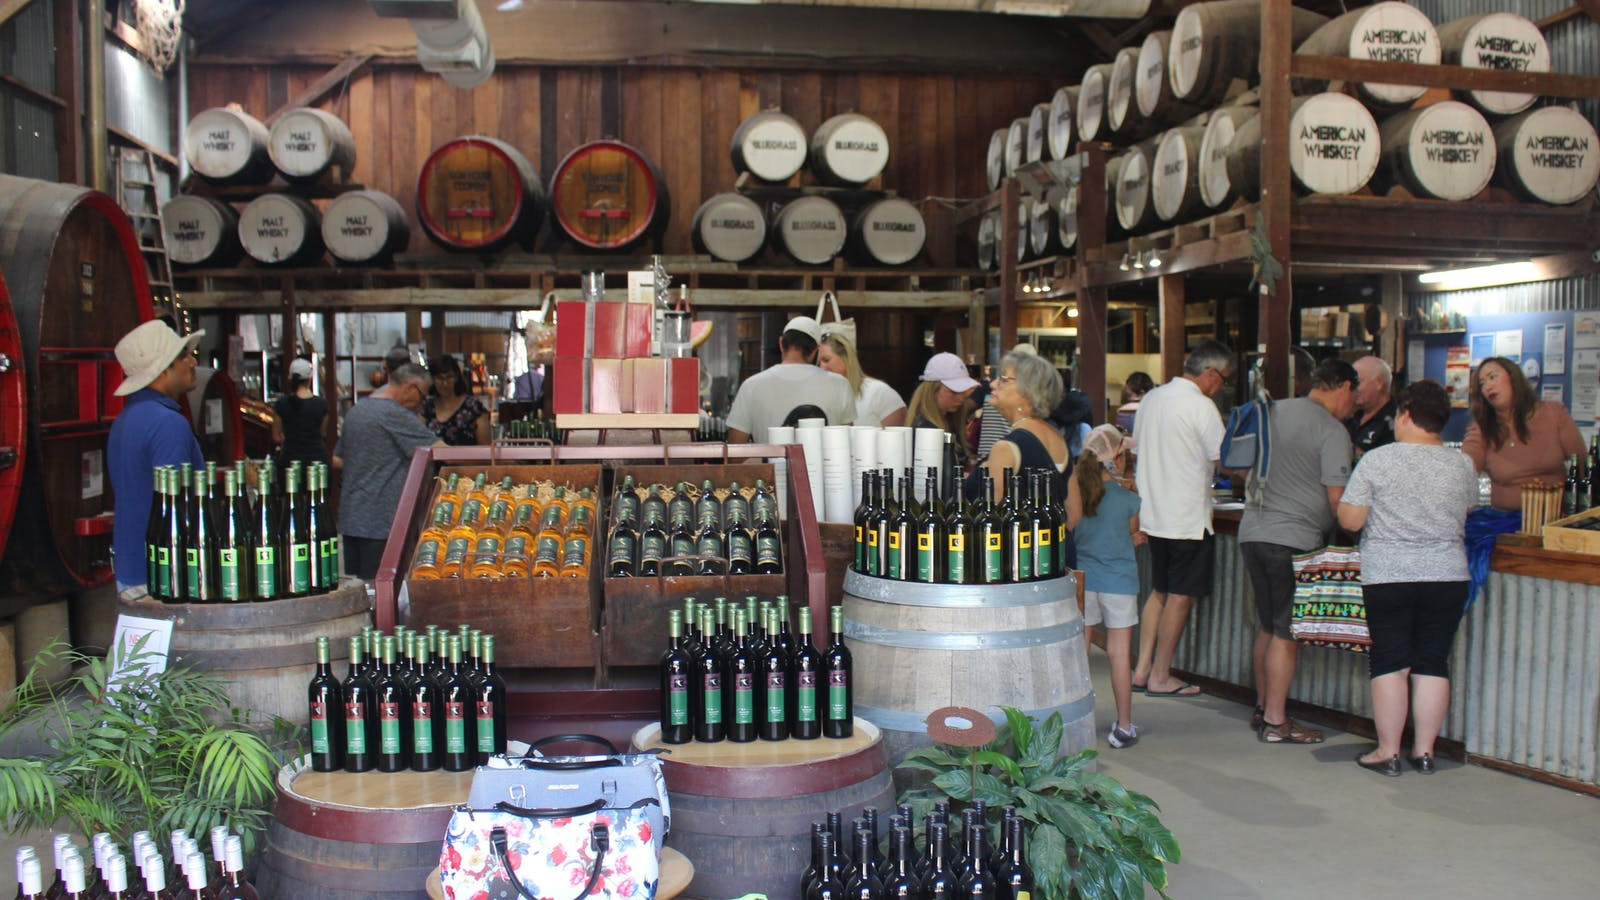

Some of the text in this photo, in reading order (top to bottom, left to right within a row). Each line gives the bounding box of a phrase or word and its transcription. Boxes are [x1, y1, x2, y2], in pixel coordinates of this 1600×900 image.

[1362, 30, 1426, 44] AMERICAN
[1475, 36, 1536, 56] AMERICAN
[1368, 48, 1422, 62] WHISKEY
[1478, 52, 1531, 71] WHISKEY
[208, 130, 230, 140] MALT
[290, 131, 311, 140] MALT
[1300, 126, 1365, 142] AMERICAN
[1421, 130, 1484, 145] AMERICAN
[203, 142, 235, 151] WHISKY
[285, 142, 316, 152] WHISKY
[835, 141, 878, 152] BLUEGRASS
[1526, 136, 1588, 151] AMERICAN
[1305, 144, 1361, 160] WHISKEY
[1426, 147, 1479, 163] WHISKEY
[1531, 154, 1584, 168] WHISKEY
[179, 220, 200, 230] MALT
[262, 217, 283, 226] MALT
[346, 216, 367, 225] MALT
[258, 228, 288, 238] WHISKY
[341, 227, 373, 237] WHISKY
